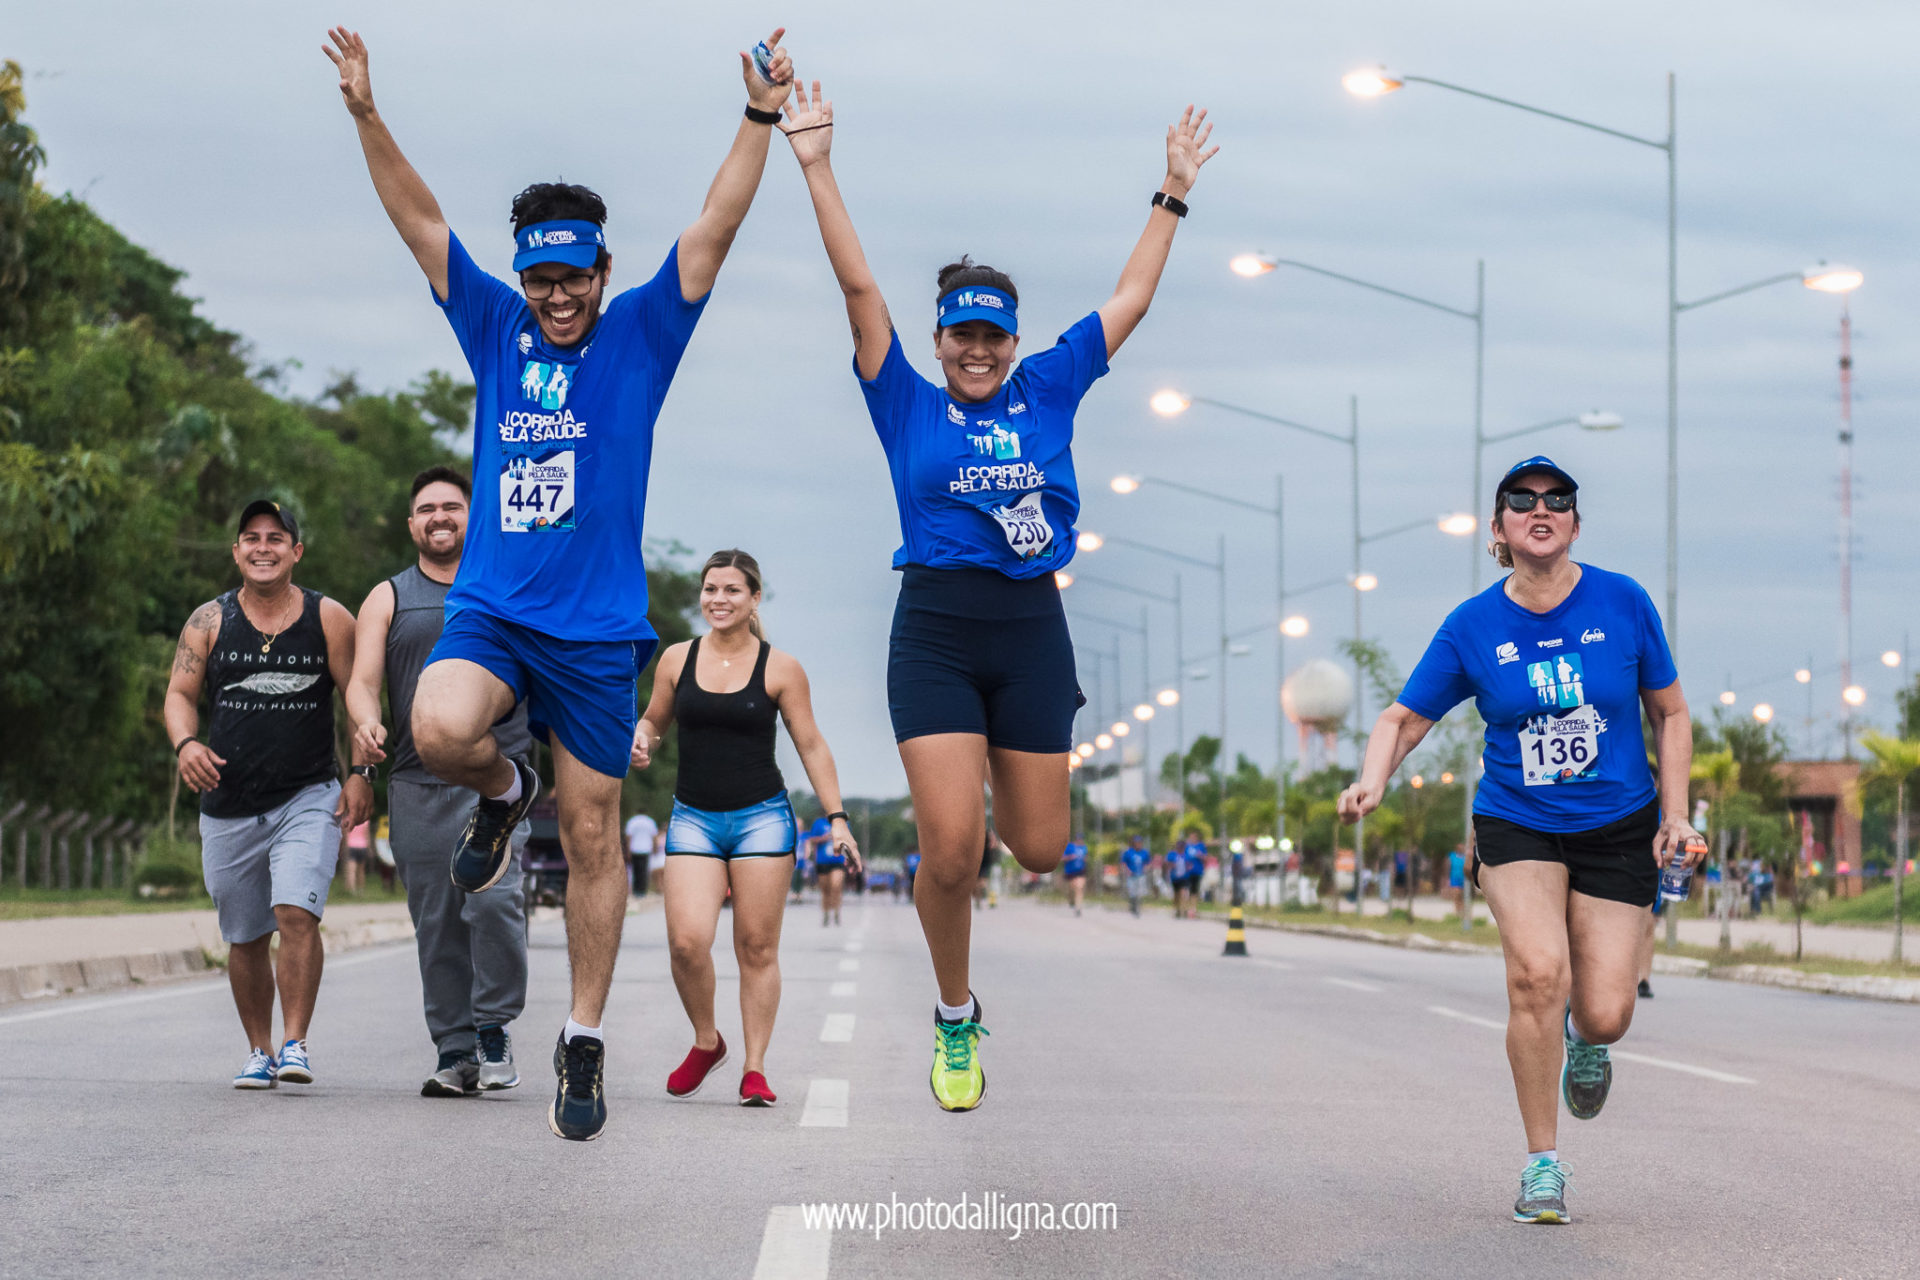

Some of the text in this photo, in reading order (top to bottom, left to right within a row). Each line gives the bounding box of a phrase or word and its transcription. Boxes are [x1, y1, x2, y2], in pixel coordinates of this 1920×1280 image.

[532, 422, 588, 442] SAUDE
[966, 461, 1038, 480] CORRIDA
[950, 471, 1046, 493] PELA SAUDE
[508, 484, 564, 513] 447
[1007, 521, 1047, 545] 230
[220, 651, 324, 664] JOHN JOHN
[220, 700, 318, 710] MADE IN HEAVEN
[1531, 736, 1589, 765] 136
